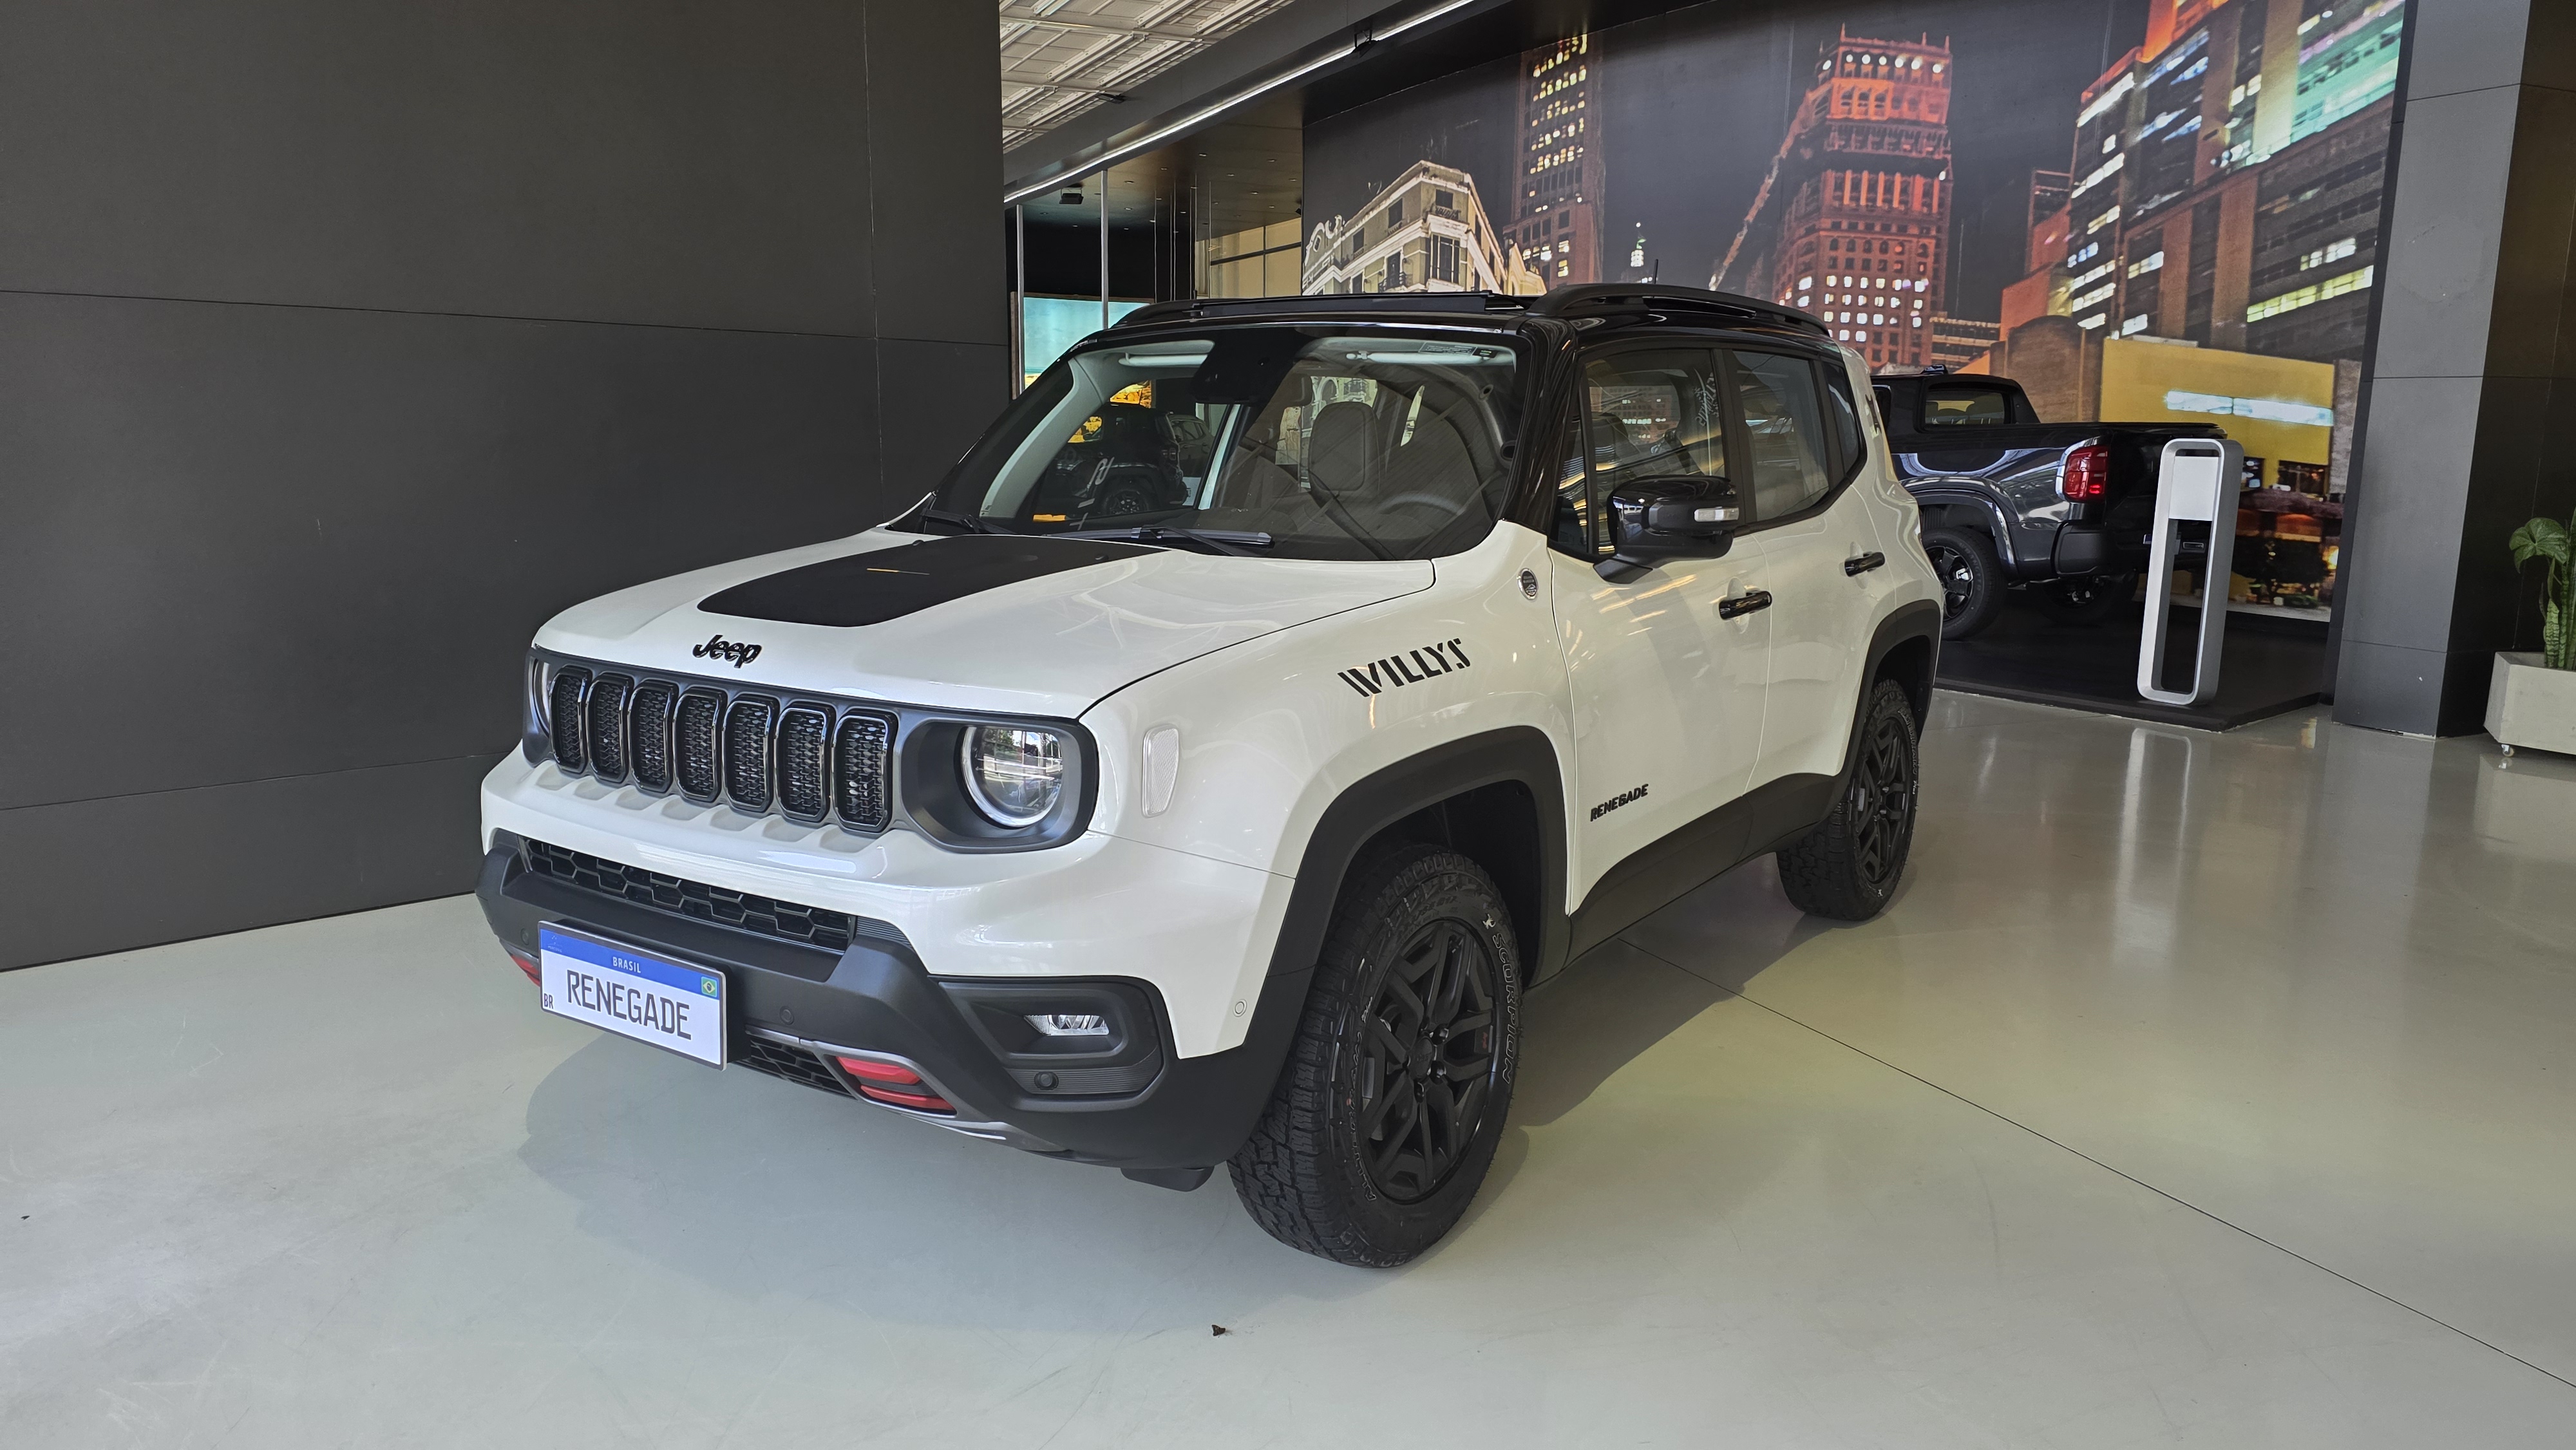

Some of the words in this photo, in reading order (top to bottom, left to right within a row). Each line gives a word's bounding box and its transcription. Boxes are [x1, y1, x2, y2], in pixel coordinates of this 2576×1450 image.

[692, 635, 762, 668] Jeep
[1338, 638, 1470, 697] WILLYS
[1590, 784, 1649, 822] RENEGADE
[612, 956, 641, 974] BRASIL
[544, 993, 554, 1010] BR
[567, 969, 692, 1040] RENEGADE
[1492, 932, 1517, 1085] SCORPION
